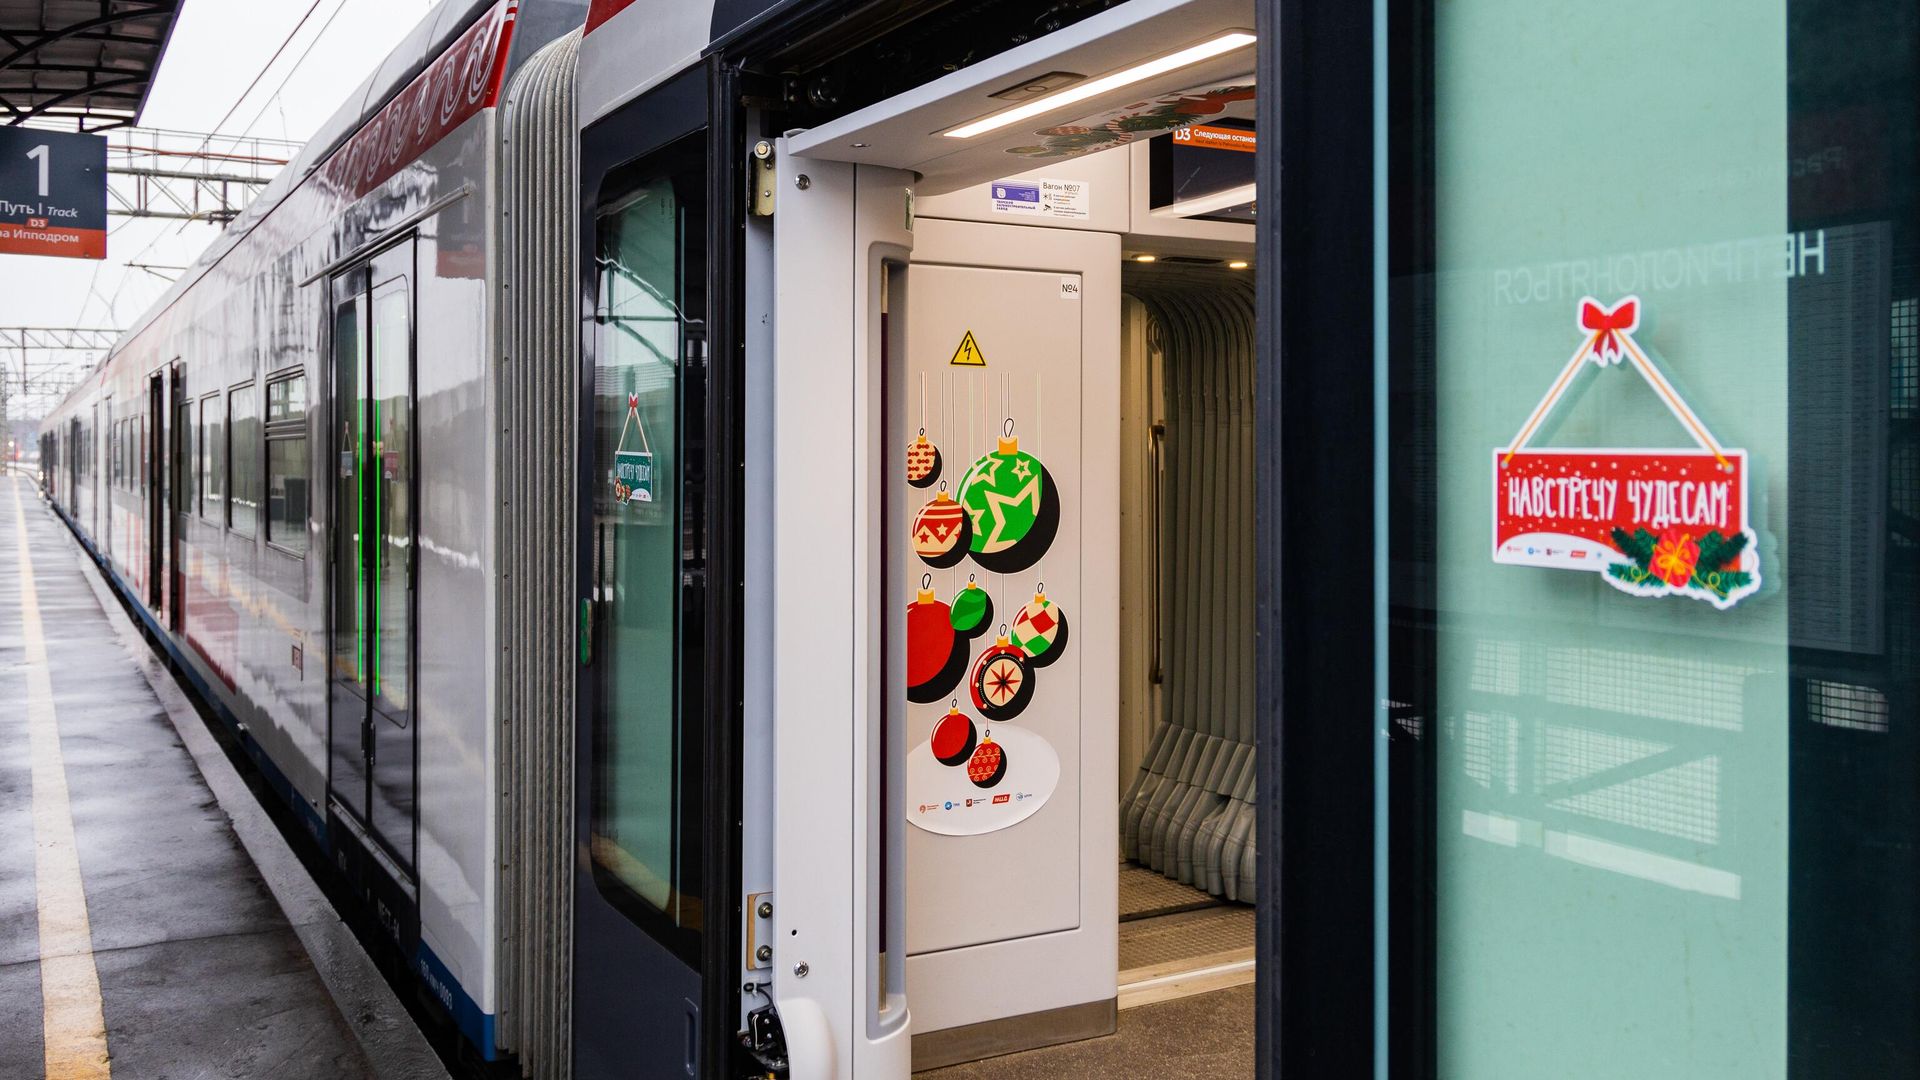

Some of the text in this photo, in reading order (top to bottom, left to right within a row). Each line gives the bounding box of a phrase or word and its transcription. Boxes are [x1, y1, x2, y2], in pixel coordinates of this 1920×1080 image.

[1193, 128, 1231, 140] Следующая
[26, 144, 49, 197] 1
[1043, 181, 1062, 191] Вагон
[0, 200, 35, 216] Путь
[47, 206, 79, 218] Track
[30, 218, 46, 227] D3
[13, 229, 80, 244] Ипподром
[1062, 284, 1078, 294] №4
[1508, 476, 1728, 529] НАВСТРЕЧУ ЧУДЕСАМ
